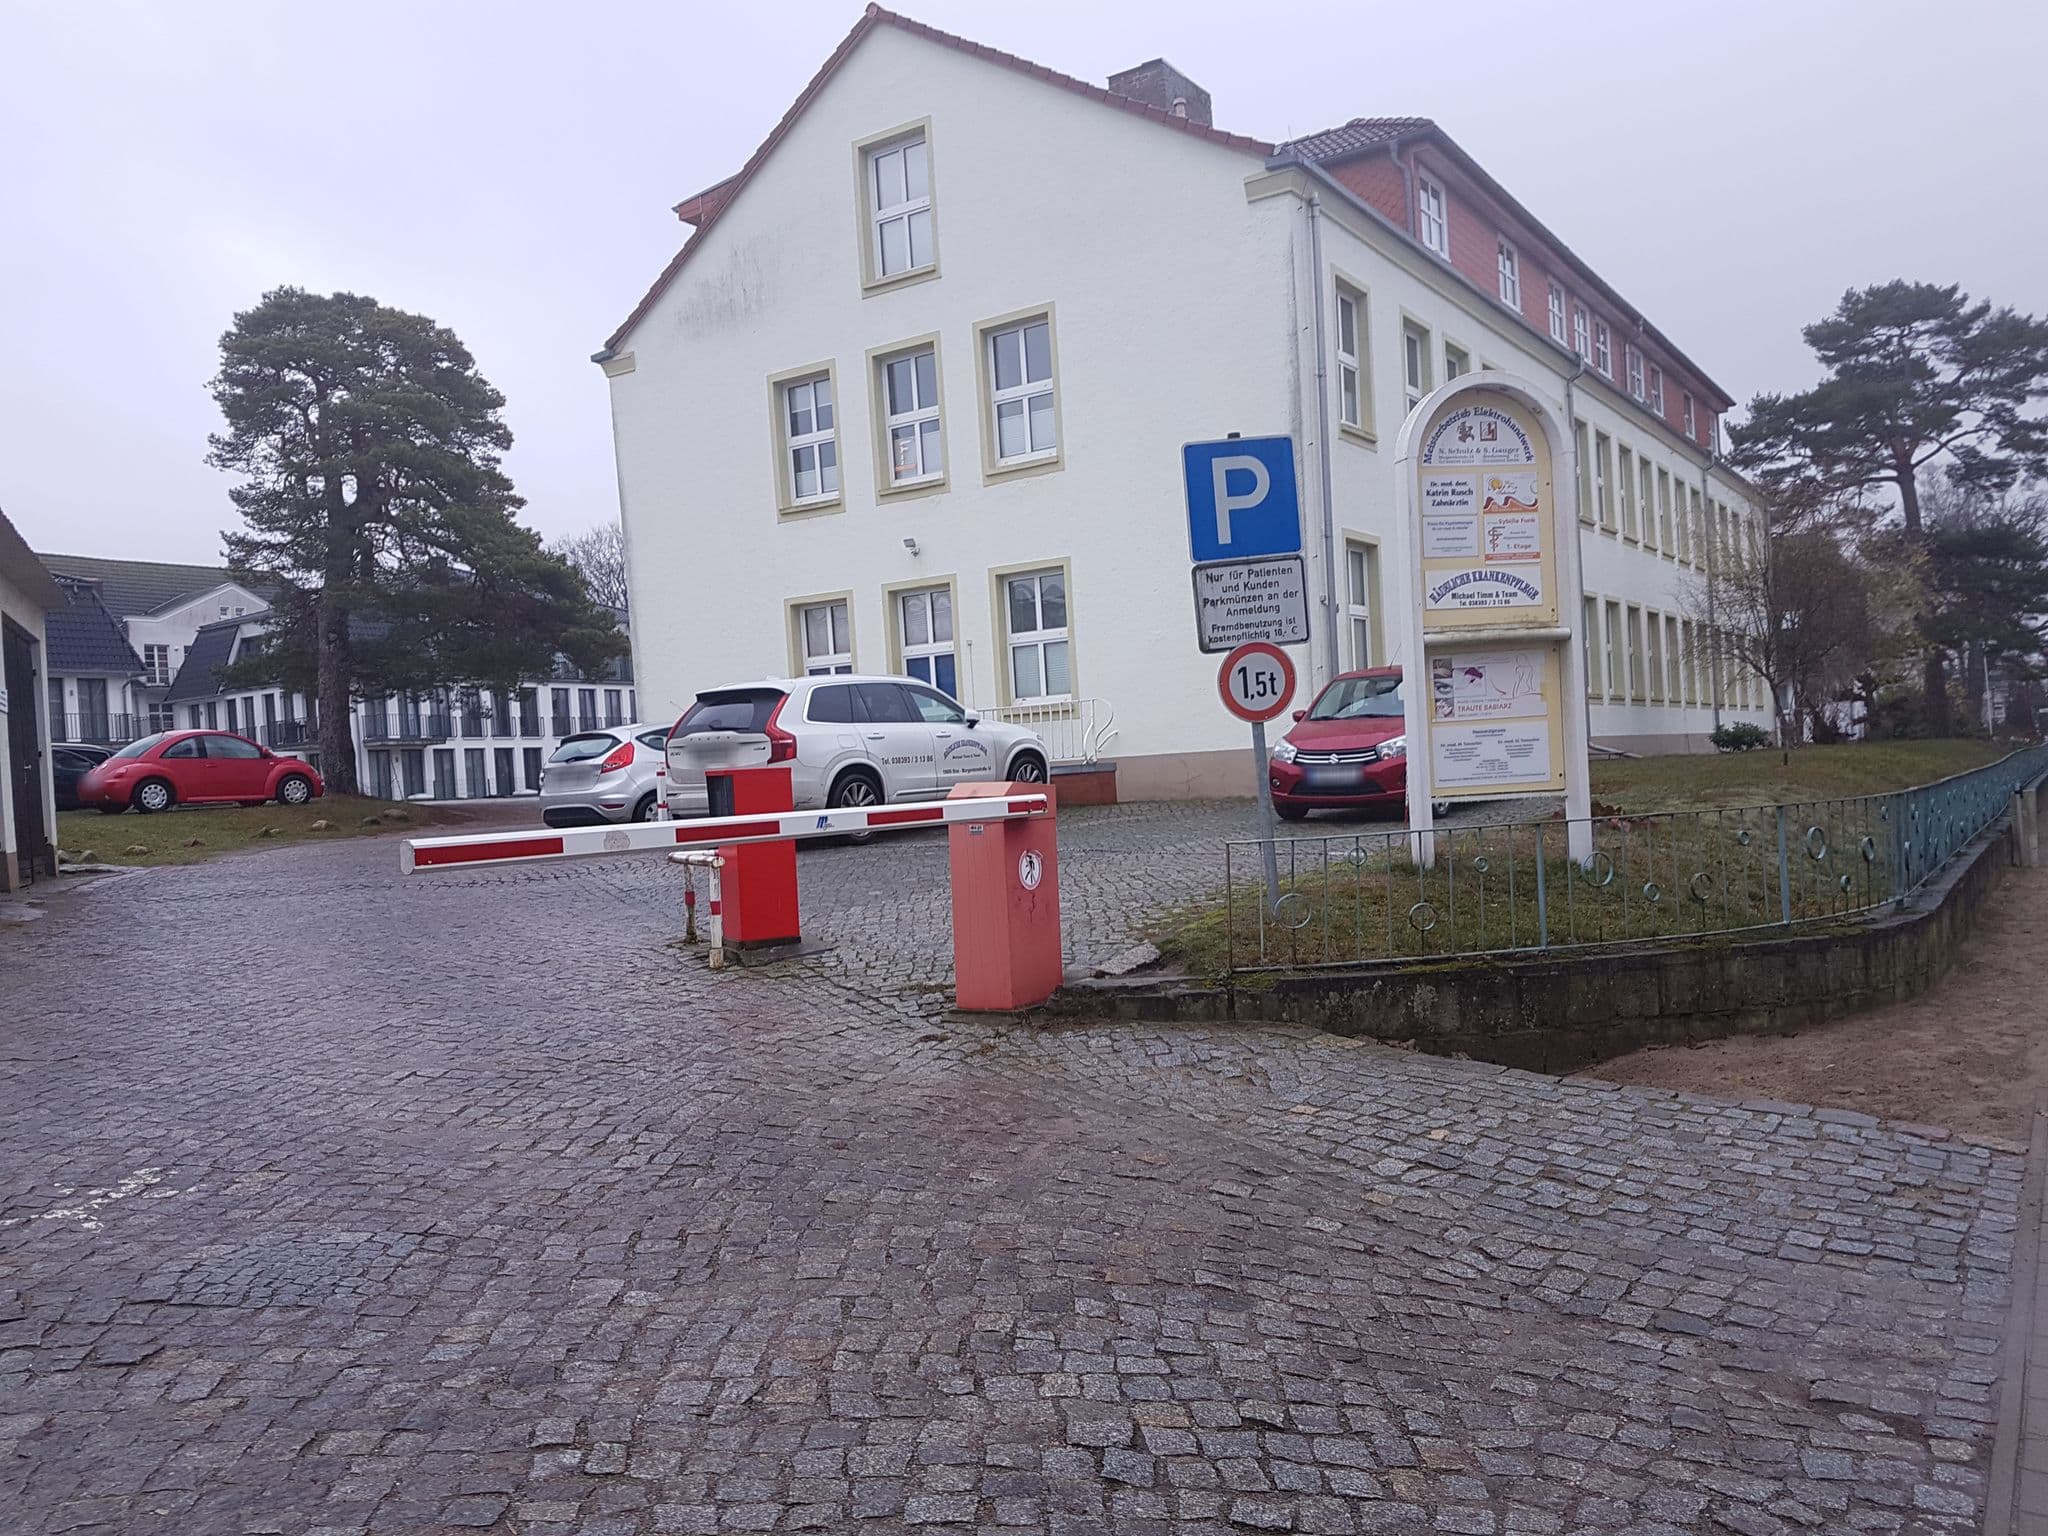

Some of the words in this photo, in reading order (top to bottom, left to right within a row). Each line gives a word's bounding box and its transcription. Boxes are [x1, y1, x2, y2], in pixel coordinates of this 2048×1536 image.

[1423, 408, 1471, 464] Meisterbetrieb
[1473, 406, 1535, 462] Elektrohandwerk
[1211, 455, 1270, 544] P
[1426, 488, 1449, 496] Katrin
[1432, 498, 1469, 507] Zahnärztin
[1206, 573, 1224, 583] Nur
[1229, 570, 1244, 580] für
[1247, 566, 1293, 579] Patienten
[1222, 583, 1240, 593] und
[1243, 580, 1280, 592] Kunden
[1472, 570, 1540, 600] KRANKENPFLEGE
[1203, 594, 1264, 609] Parkmünzen
[1282, 590, 1299, 599] der
[1451, 592, 1475, 600] Michael
[1226, 604, 1280, 617] Anmeldung
[1211, 618, 1282, 634] Fremdbenutzung
[1286, 617, 1296, 625] ist
[1208, 629, 1270, 644] kostenpflichtig
